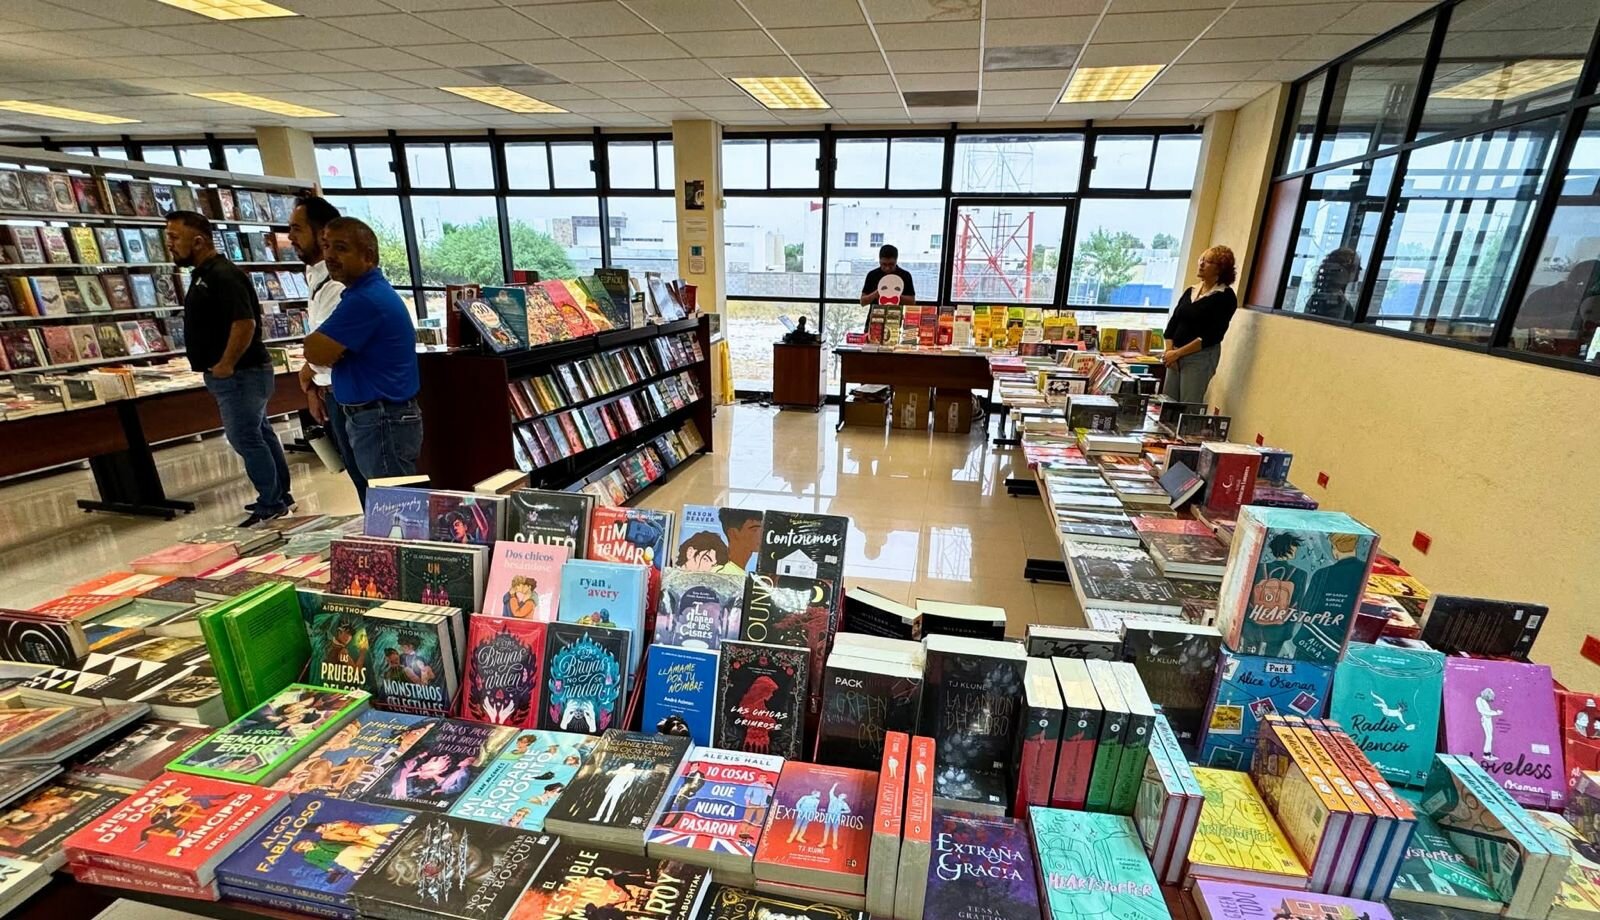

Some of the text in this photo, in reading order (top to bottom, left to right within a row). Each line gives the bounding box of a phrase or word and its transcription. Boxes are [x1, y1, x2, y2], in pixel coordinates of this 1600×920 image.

[766, 528, 843, 548] Contenemos
[357, 555, 370, 569] EL
[505, 549, 555, 562] Dos chicos
[427, 562, 440, 574] UN
[579, 576, 606, 588] ryan
[588, 587, 620, 600] avery
[322, 604, 368, 615] AIDEN THOM
[746, 574, 775, 643] OUND
[1248, 603, 1345, 627] HEARTSTOPPER
[339, 654, 349, 663] LAS
[477, 647, 527, 671] Brujas
[559, 655, 609, 679] Brujas
[1268, 663, 1289, 673] Pack
[320, 662, 367, 685] PRUEBAS
[835, 677, 863, 689] PACK
[1237, 672, 1317, 692] Alice Oseman
[383, 680, 443, 702] MONSTRUOS
[960, 682, 988, 691] KLUNE
[730, 706, 788, 720] LAS CHICAS
[733, 718, 783, 731] GRIMROSE
[1351, 714, 1400, 738] Radio
[210, 734, 298, 745] SEMANTIC
[610, 739, 674, 751] CUANDO CIERRO
[703, 752, 773, 767] ALEXIS HALL
[1469, 751, 1553, 780] oveless
[474, 748, 540, 819] PROBABLE
[706, 766, 756, 782] 10 COSAS
[491, 751, 551, 821] FAVORITO
[711, 784, 738, 799] QUE
[93, 778, 178, 834] HISTORIA
[456, 794, 479, 817] MI
[694, 801, 737, 819] NUNCA
[99, 825, 128, 844] DE
[129, 797, 166, 824] DOS
[166, 792, 254, 858] PRÍNCIPES
[679, 818, 738, 837] PASARON
[774, 804, 865, 831] EXTRAORDINARIOS
[204, 831, 229, 851] ERIC
[256, 799, 323, 874] FABULOSO
[262, 815, 292, 849] ALGO
[353, 824, 410, 880] ALEXIS HALL
[936, 832, 1025, 865] EXTRAÑA
[1405, 847, 1466, 863] STOPPER
[476, 836, 538, 913] AL BOSQUE
[936, 853, 1025, 881] GRACIA
[542, 880, 557, 890] EL
[543, 850, 600, 920] NESTABLE
[1049, 873, 1154, 898] HEARTSTOPPER
[466, 894, 481, 910] NO
[967, 905, 1001, 916] TESSA
[958, 911, 1009, 920] GRATTO
